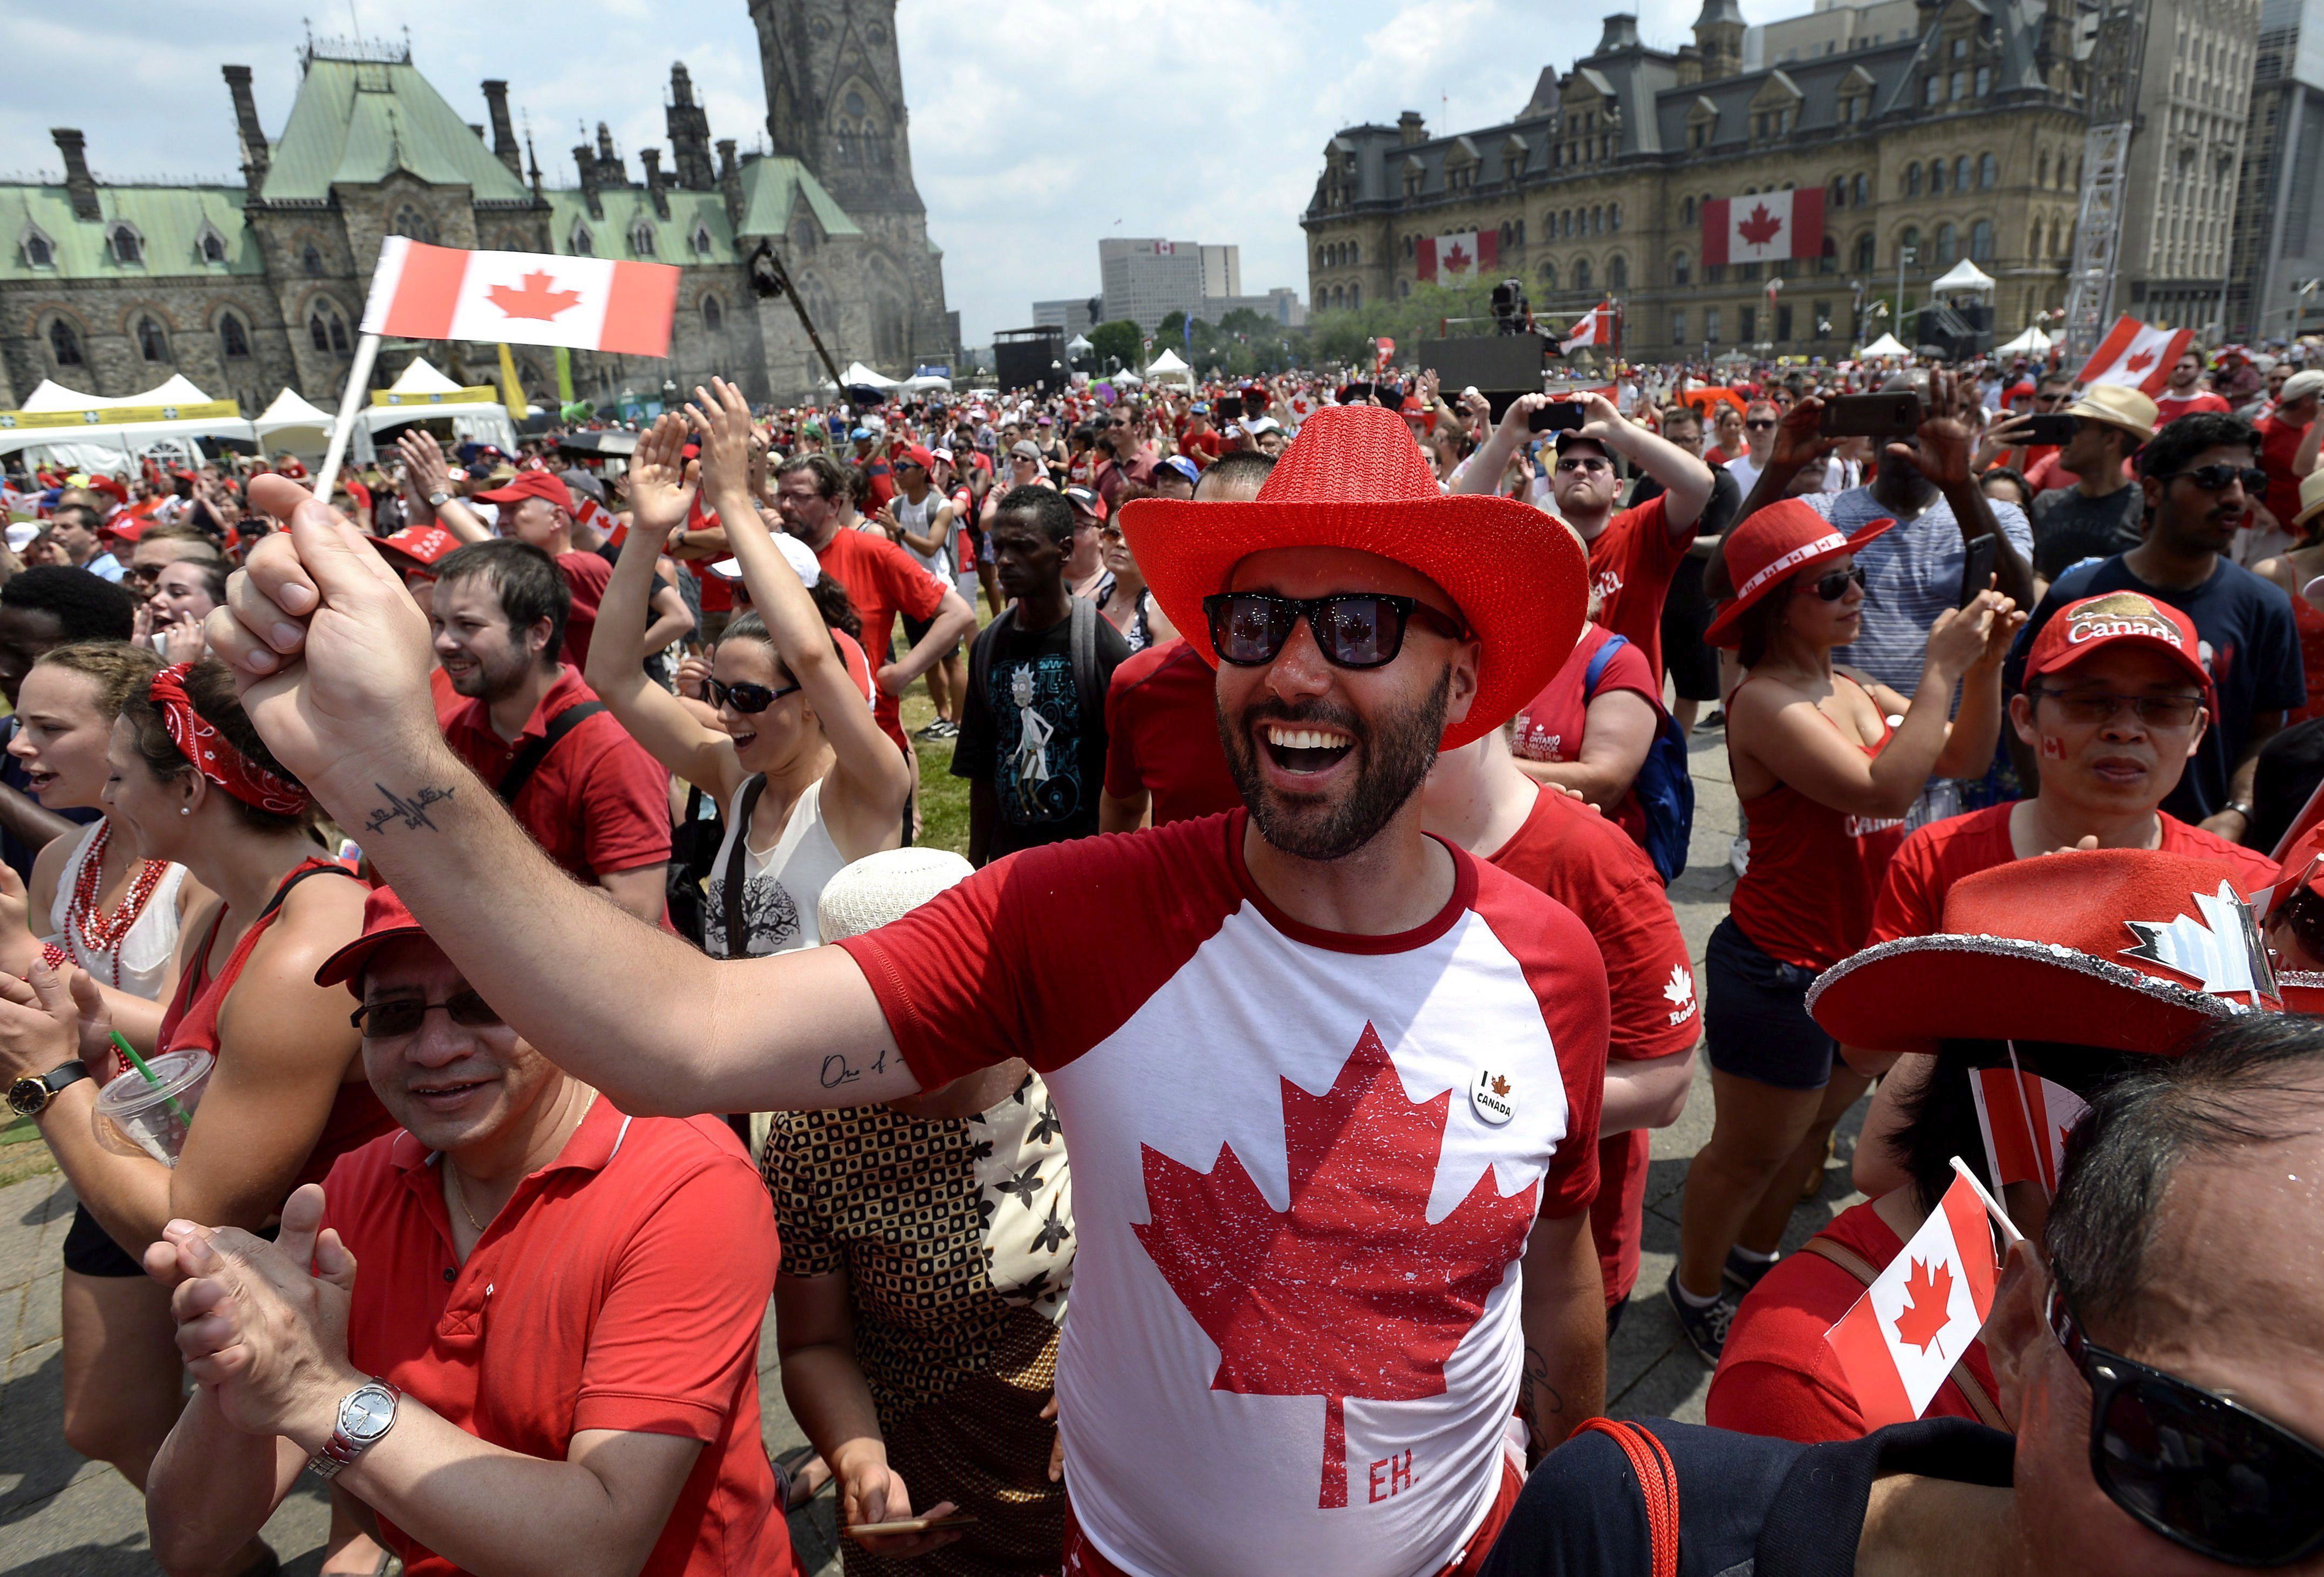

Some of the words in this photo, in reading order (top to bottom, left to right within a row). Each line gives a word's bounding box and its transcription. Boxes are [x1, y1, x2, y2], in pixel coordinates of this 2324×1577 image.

[2068, 620, 2182, 649] Canada
[1529, 735, 1561, 746] ONTARIO
[821, 1054, 860, 1088] One
[871, 1050, 885, 1074] of
[1481, 1070, 1488, 1087] I
[1477, 1093, 1511, 1117] CANADA
[1369, 1448, 1420, 1504] EH.
